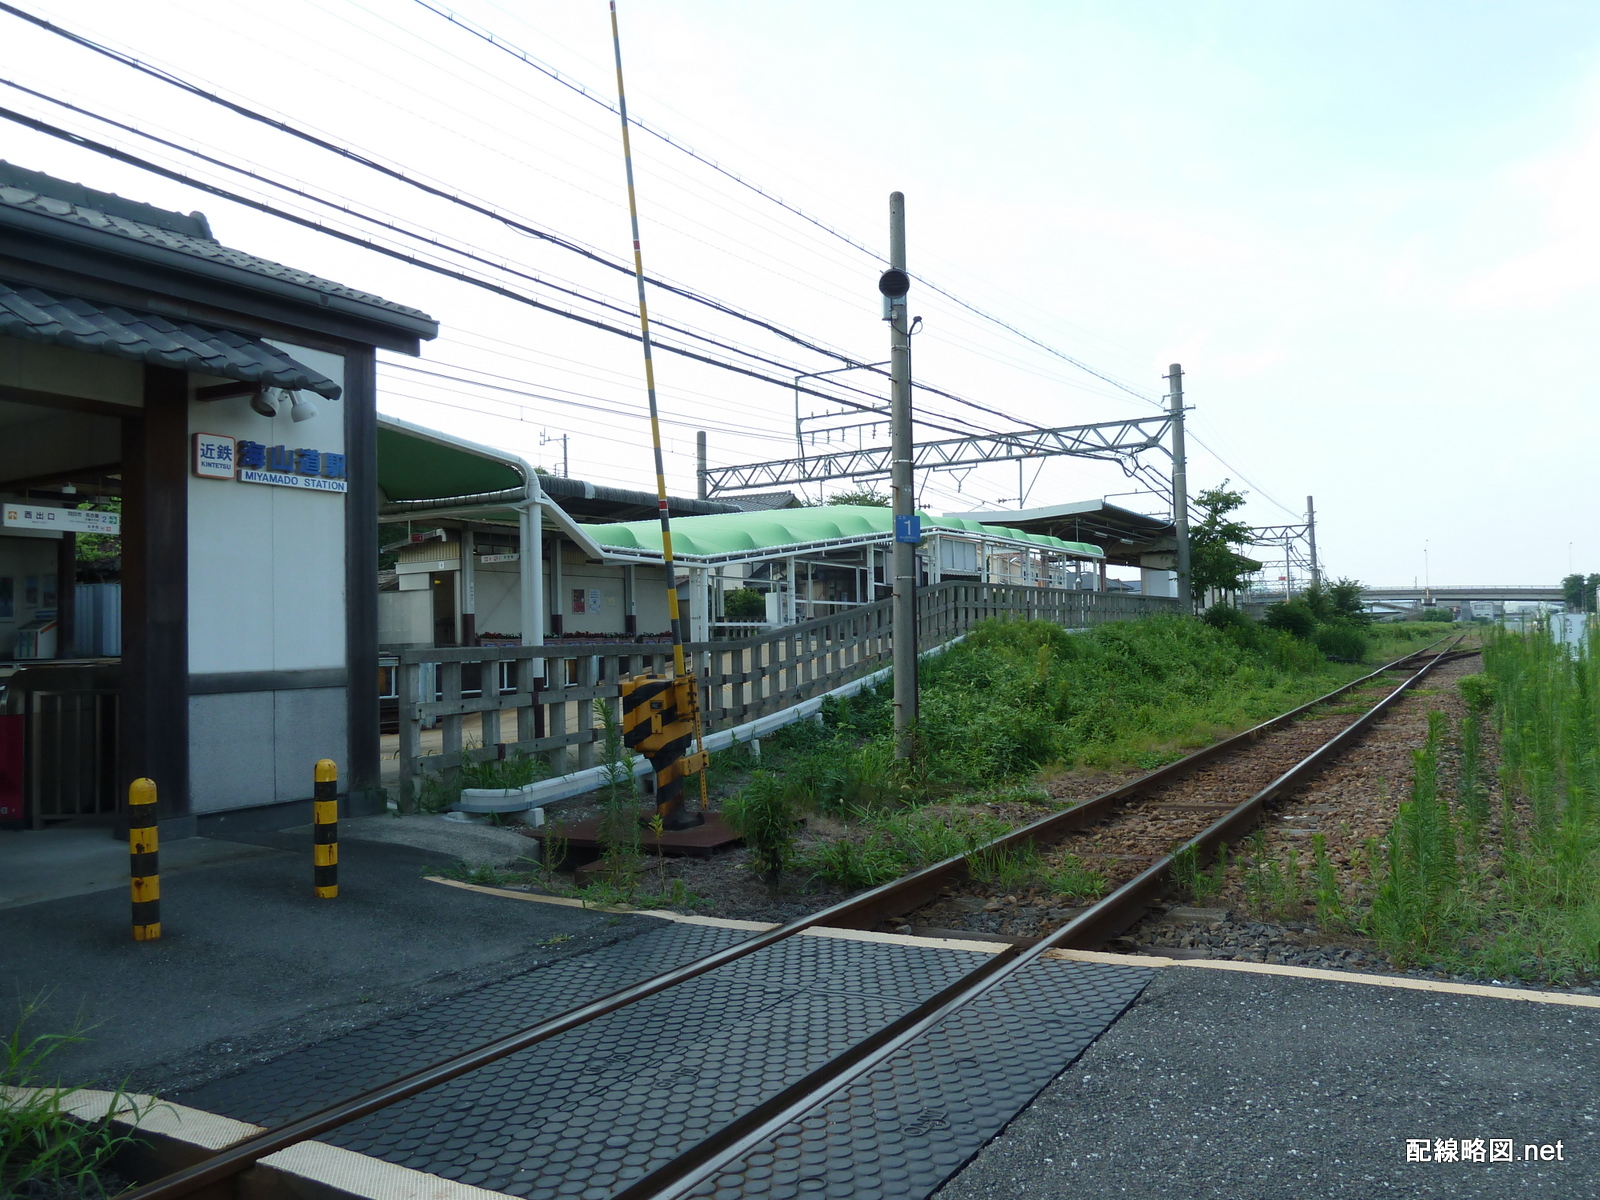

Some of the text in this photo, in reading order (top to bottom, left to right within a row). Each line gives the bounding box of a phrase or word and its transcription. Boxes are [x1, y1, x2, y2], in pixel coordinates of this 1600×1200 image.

[200, 442, 233, 462] 近鉄
[239, 440, 347, 479] 海山道駅
[201, 461, 232, 470] KINTETSU
[245, 470, 345, 491] MIYAMADO STATION
[904, 520, 911, 535] 1
